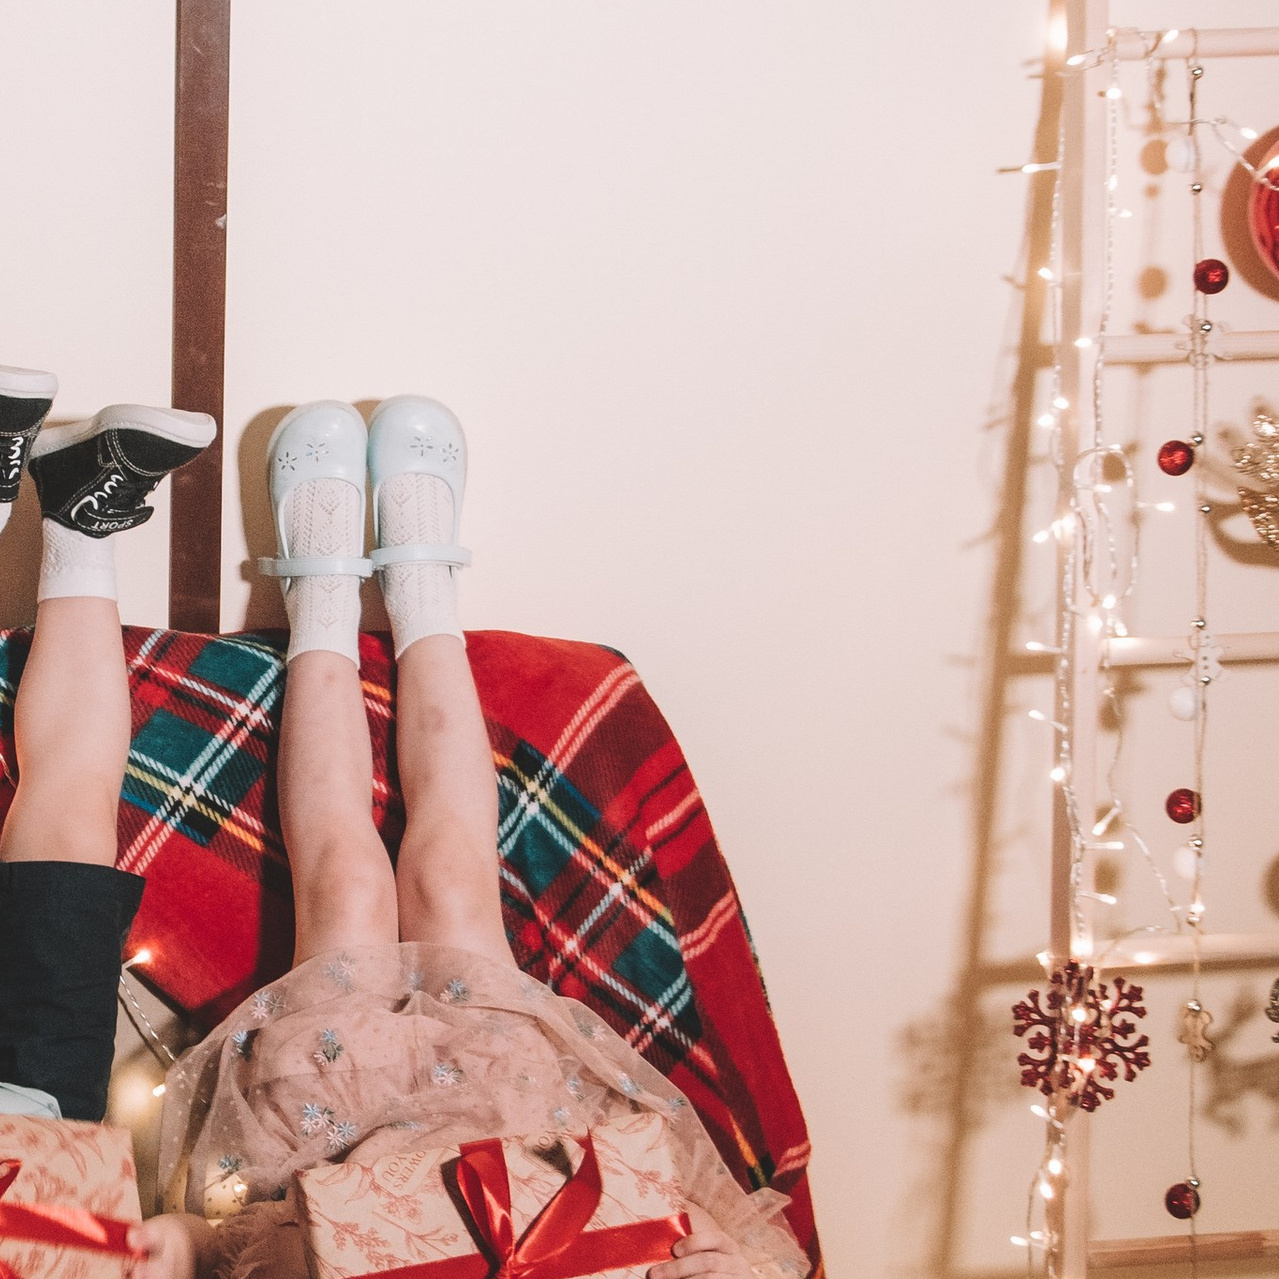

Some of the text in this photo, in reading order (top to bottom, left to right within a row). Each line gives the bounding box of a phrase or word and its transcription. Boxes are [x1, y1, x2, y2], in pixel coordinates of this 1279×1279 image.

[90, 518, 134, 530] SPORT
[380, 1157, 408, 1183] YOU
[392, 1153, 427, 1191] OWERS
